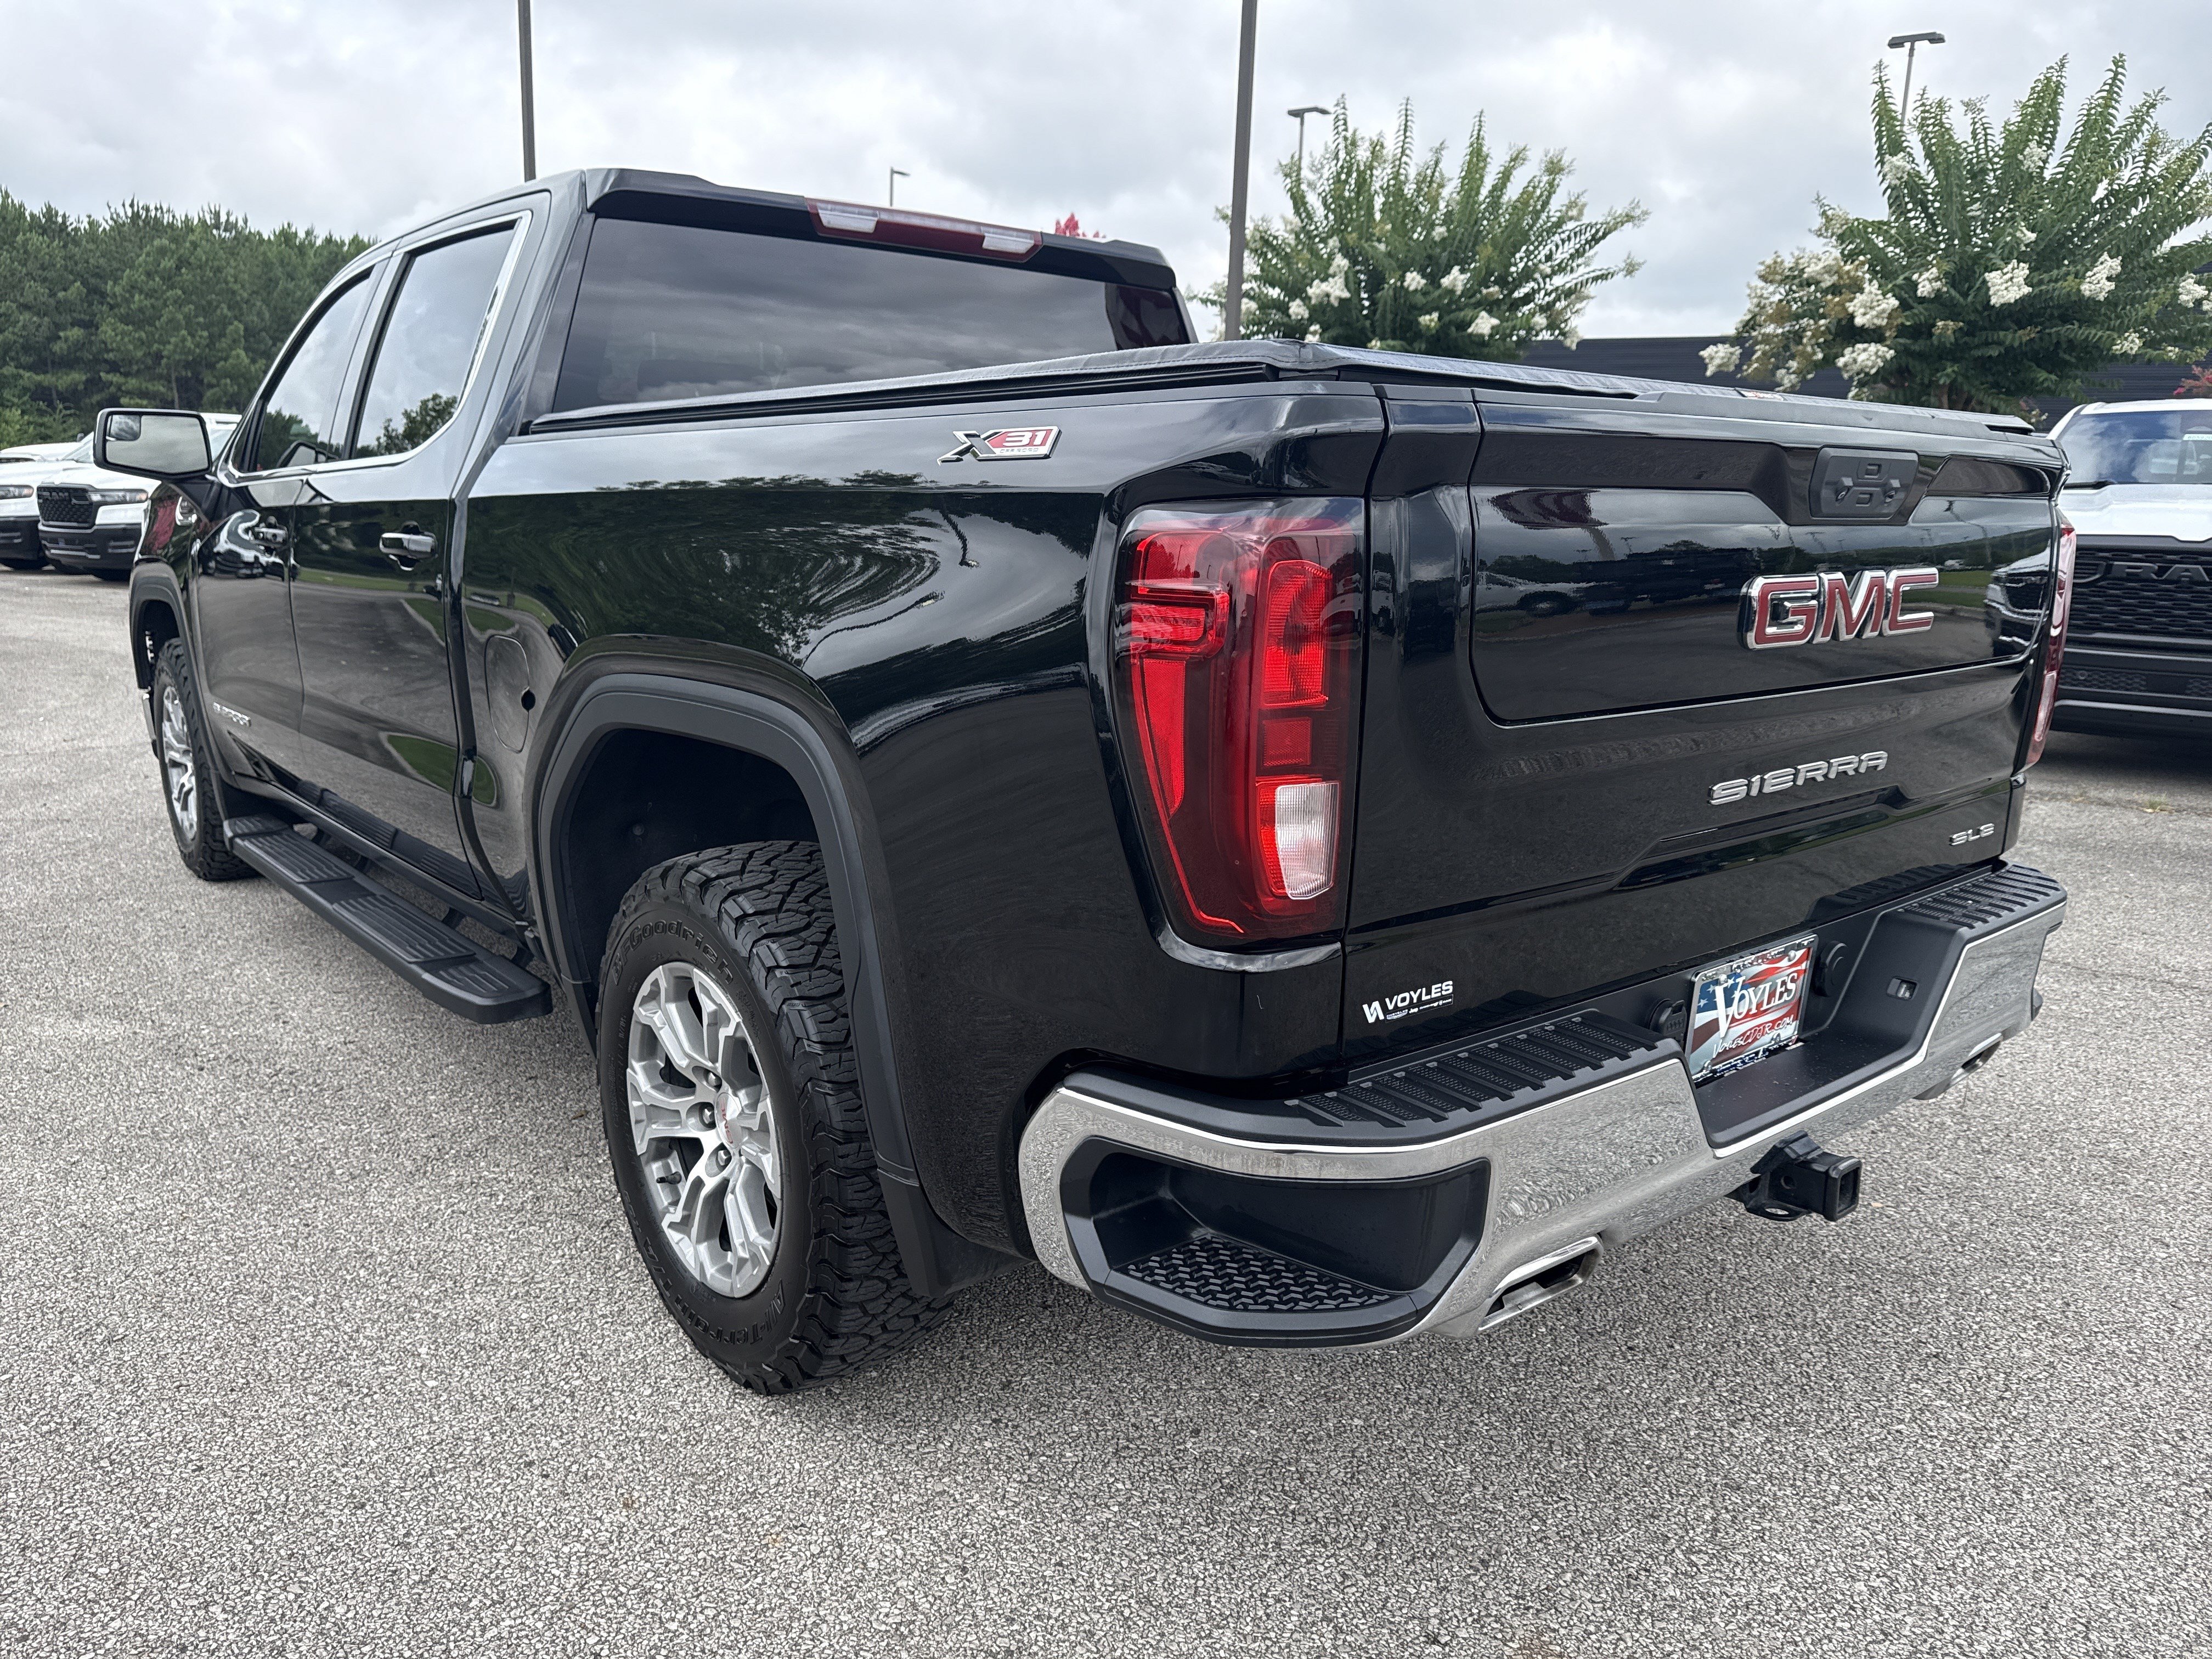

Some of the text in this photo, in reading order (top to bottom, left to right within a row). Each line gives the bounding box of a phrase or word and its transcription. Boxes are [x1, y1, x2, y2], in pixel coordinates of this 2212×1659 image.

[937, 426, 1062, 466] X31
[2112, 561, 2212, 583] RA
[1738, 567, 1939, 650] GMC
[1708, 751, 1888, 805] SIERRA
[1949, 823, 1995, 845] SLE
[612, 919, 733, 986] BFGoodrich
[1385, 980, 1453, 1010] VOYLES
[1715, 972, 1798, 1038] VOYLES
